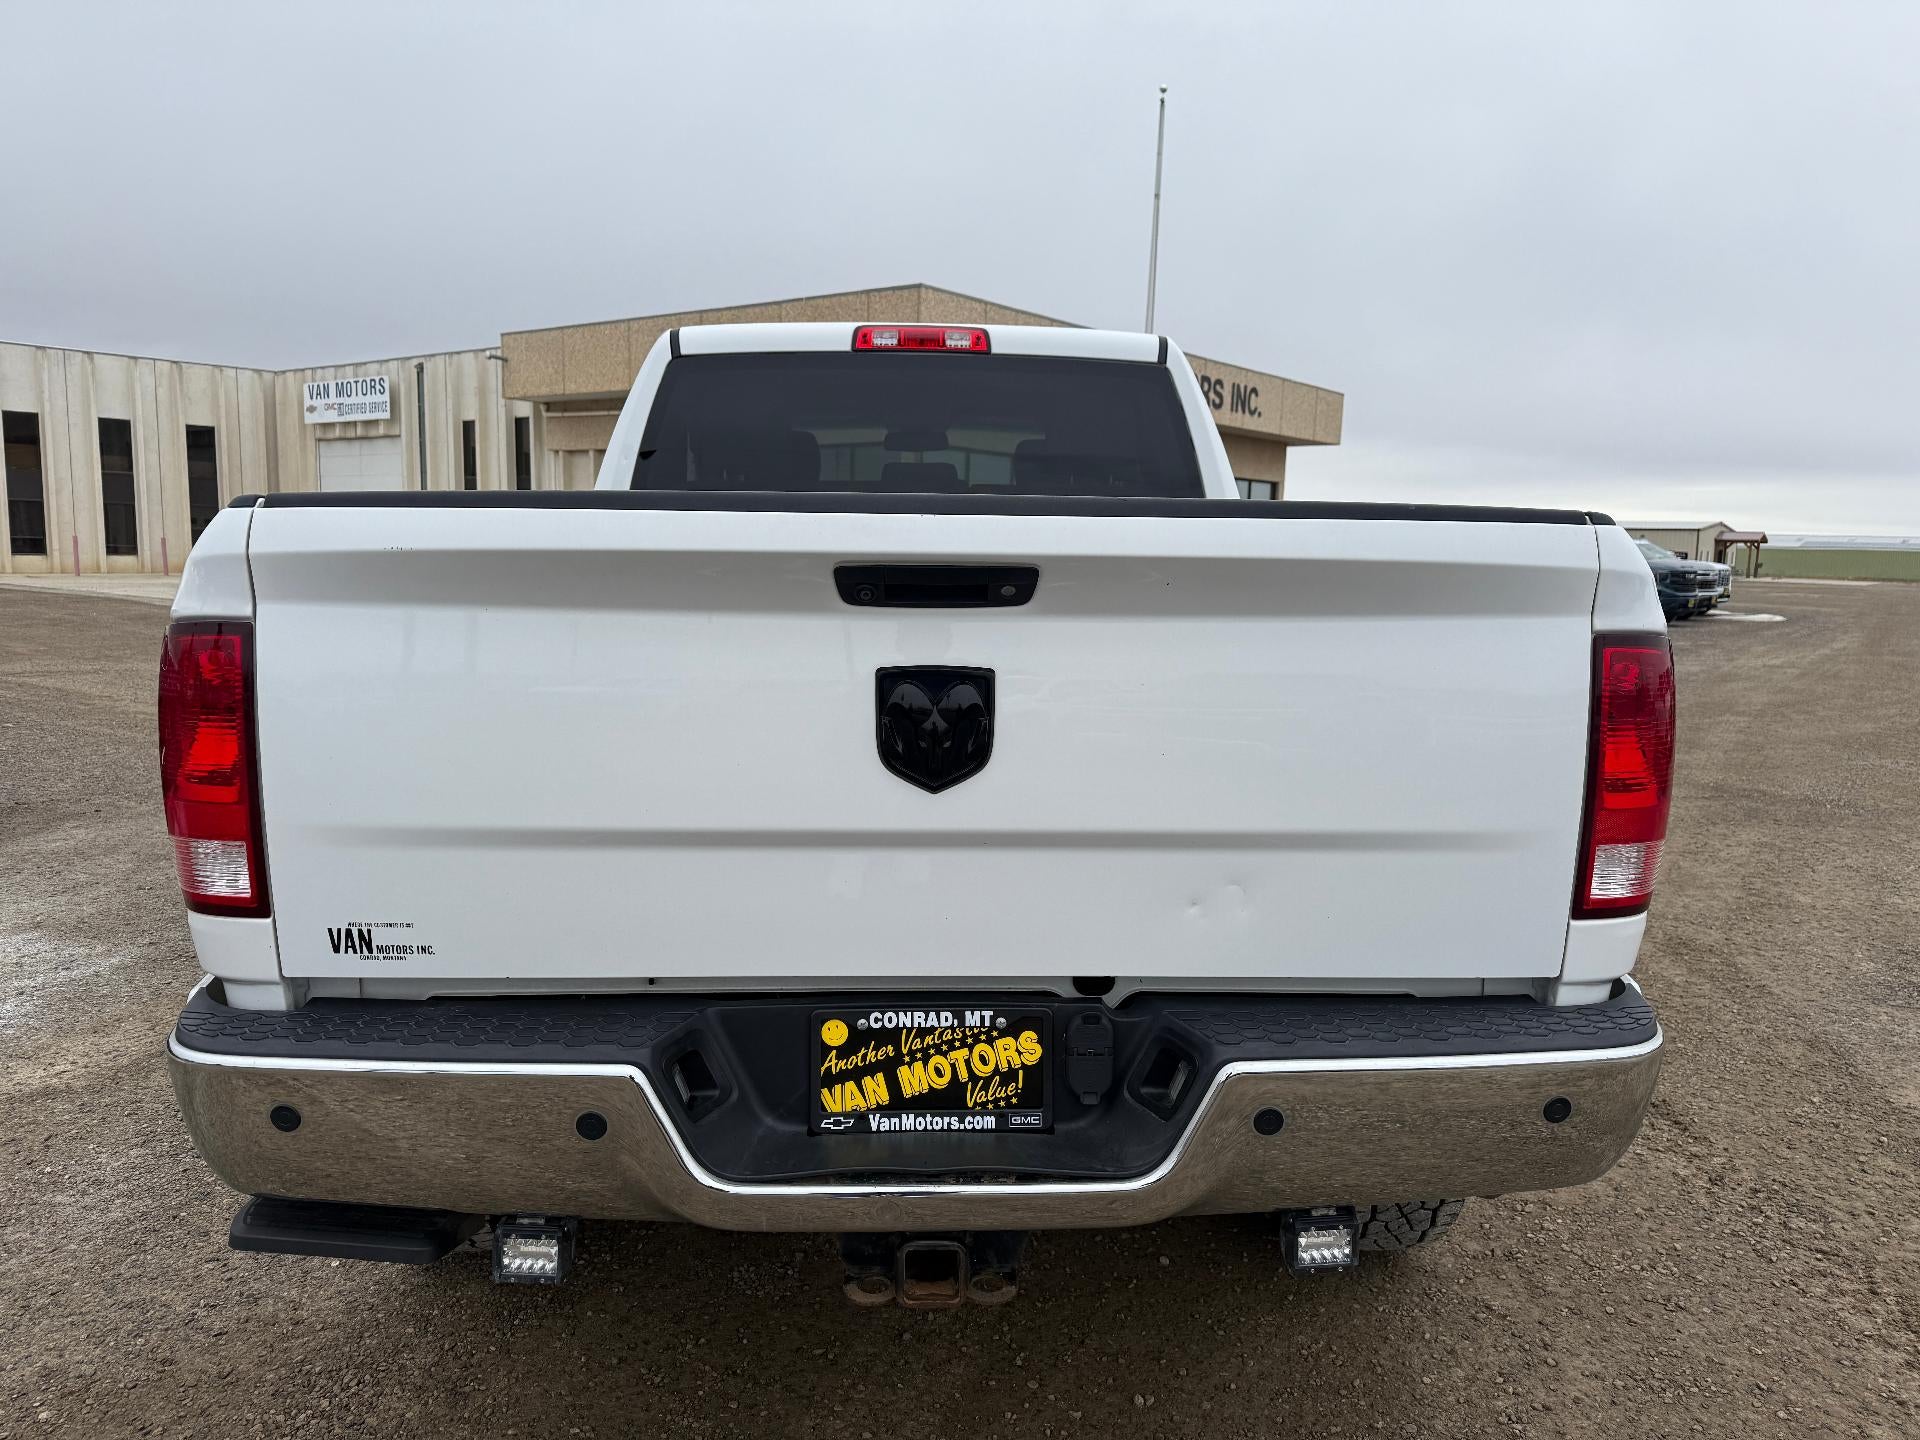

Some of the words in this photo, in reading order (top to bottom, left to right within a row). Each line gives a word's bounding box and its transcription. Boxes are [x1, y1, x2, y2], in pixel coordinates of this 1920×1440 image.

[308, 382, 330, 400] VAN
[335, 377, 386, 399] MOTORS
[1196, 373, 1225, 410] RS
[1230, 382, 1262, 418] INC.
[369, 400, 388, 413] SERVICE
[327, 928, 374, 954] VAN
[376, 944, 414, 955] MOTORS
[416, 945, 436, 955] INC.
[869, 1011, 958, 1029] CONRAD,
[965, 1010, 994, 1027] MT
[820, 1040, 895, 1078] Another
[820, 1071, 890, 1113] VAN
[896, 1030, 1043, 1099] MOTORS
[966, 1069, 1024, 1108] Value!
[868, 1113, 996, 1131] VanMotors.com
[1011, 1116, 1040, 1124] GMC
